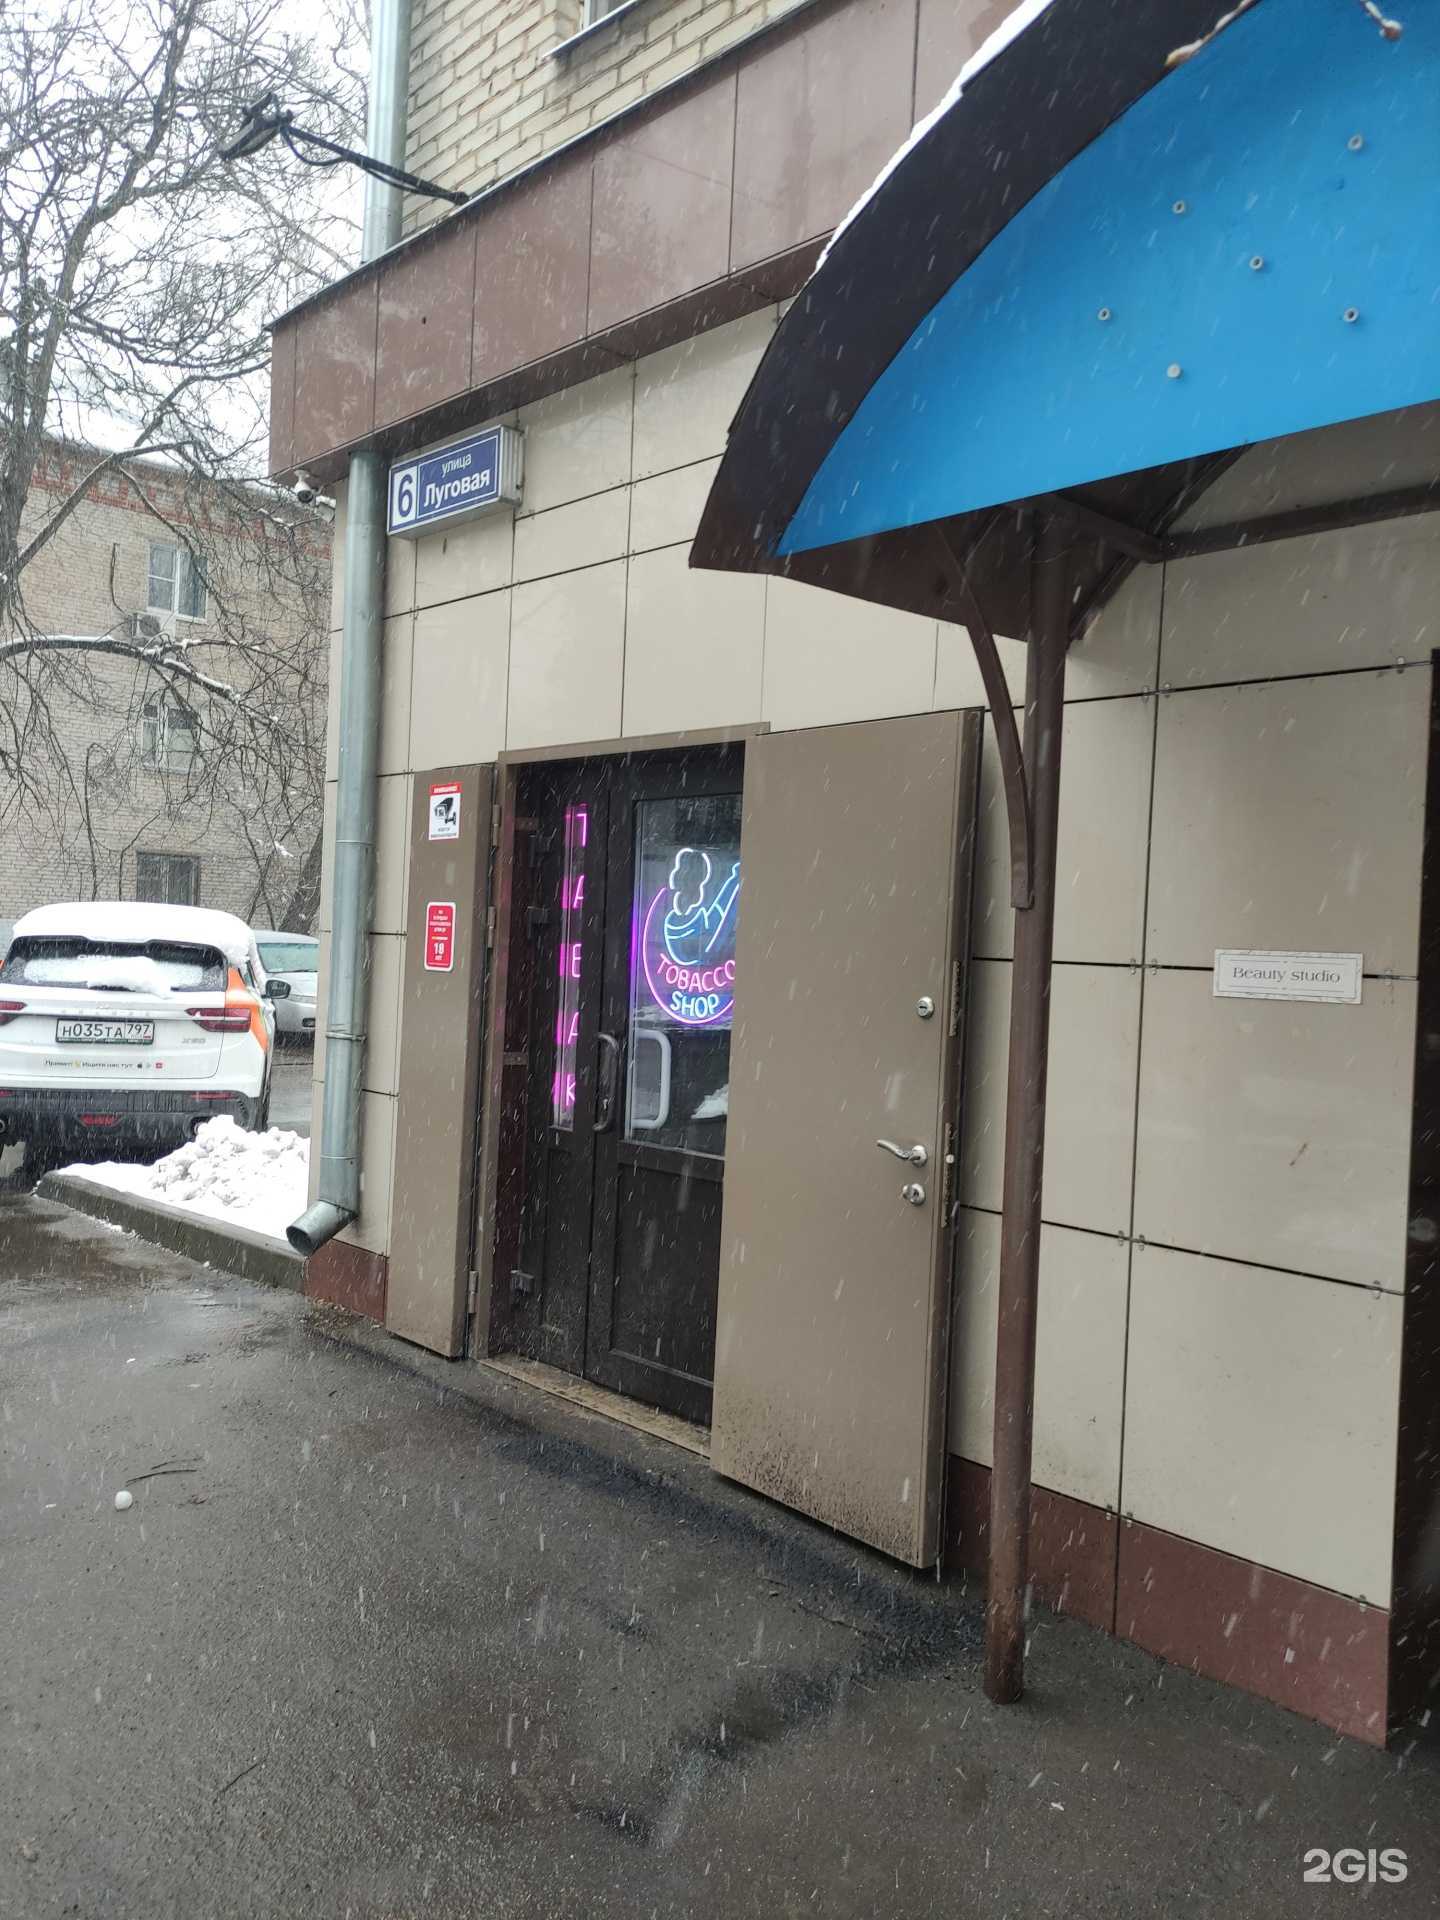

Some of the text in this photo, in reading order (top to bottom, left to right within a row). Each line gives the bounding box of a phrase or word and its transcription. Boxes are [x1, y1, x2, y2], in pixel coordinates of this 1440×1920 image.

[441, 453, 472, 478] улица
[398, 474, 413, 517] 6
[424, 468, 491, 509] Луговая
[433, 942, 445, 955] 18
[1232, 966, 1341, 984] Beauty studio
[669, 990, 720, 1018] SHOP
